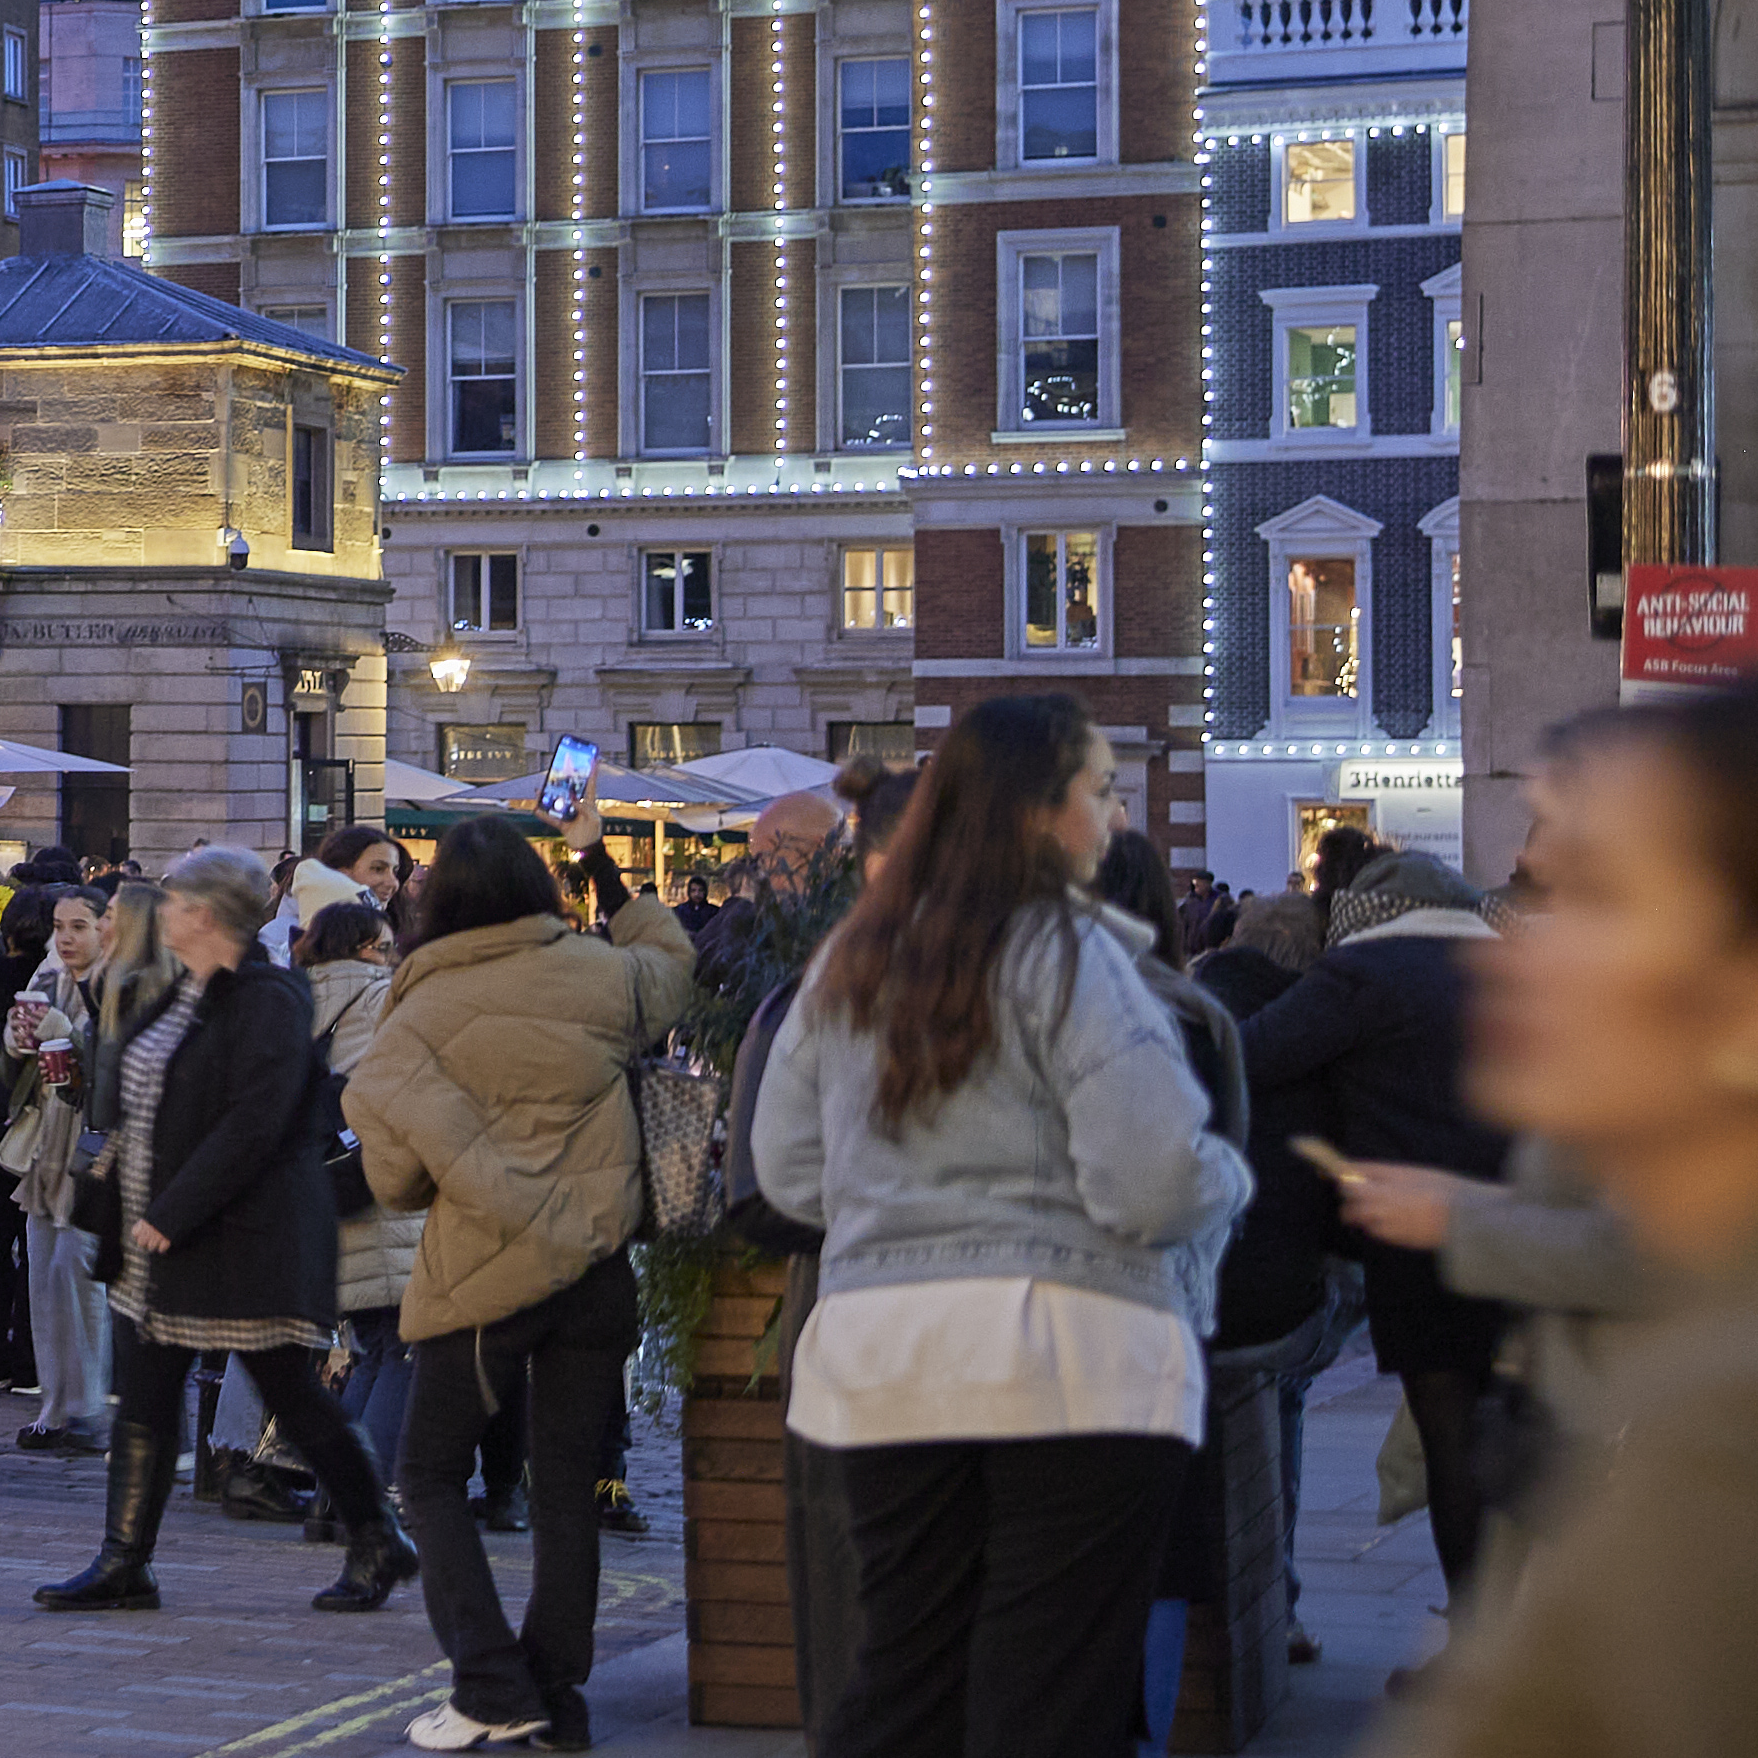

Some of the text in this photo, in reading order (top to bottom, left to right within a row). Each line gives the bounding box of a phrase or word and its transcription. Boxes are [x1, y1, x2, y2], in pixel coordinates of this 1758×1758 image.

[1648, 370, 1677, 412] 6
[1637, 591, 1749, 617] ANTI-SOCIAL
[1644, 614, 1744, 639] BEHAVIOUR
[1643, 658, 1738, 675] ASB Focus Area
[487, 750, 513, 760] IVY
